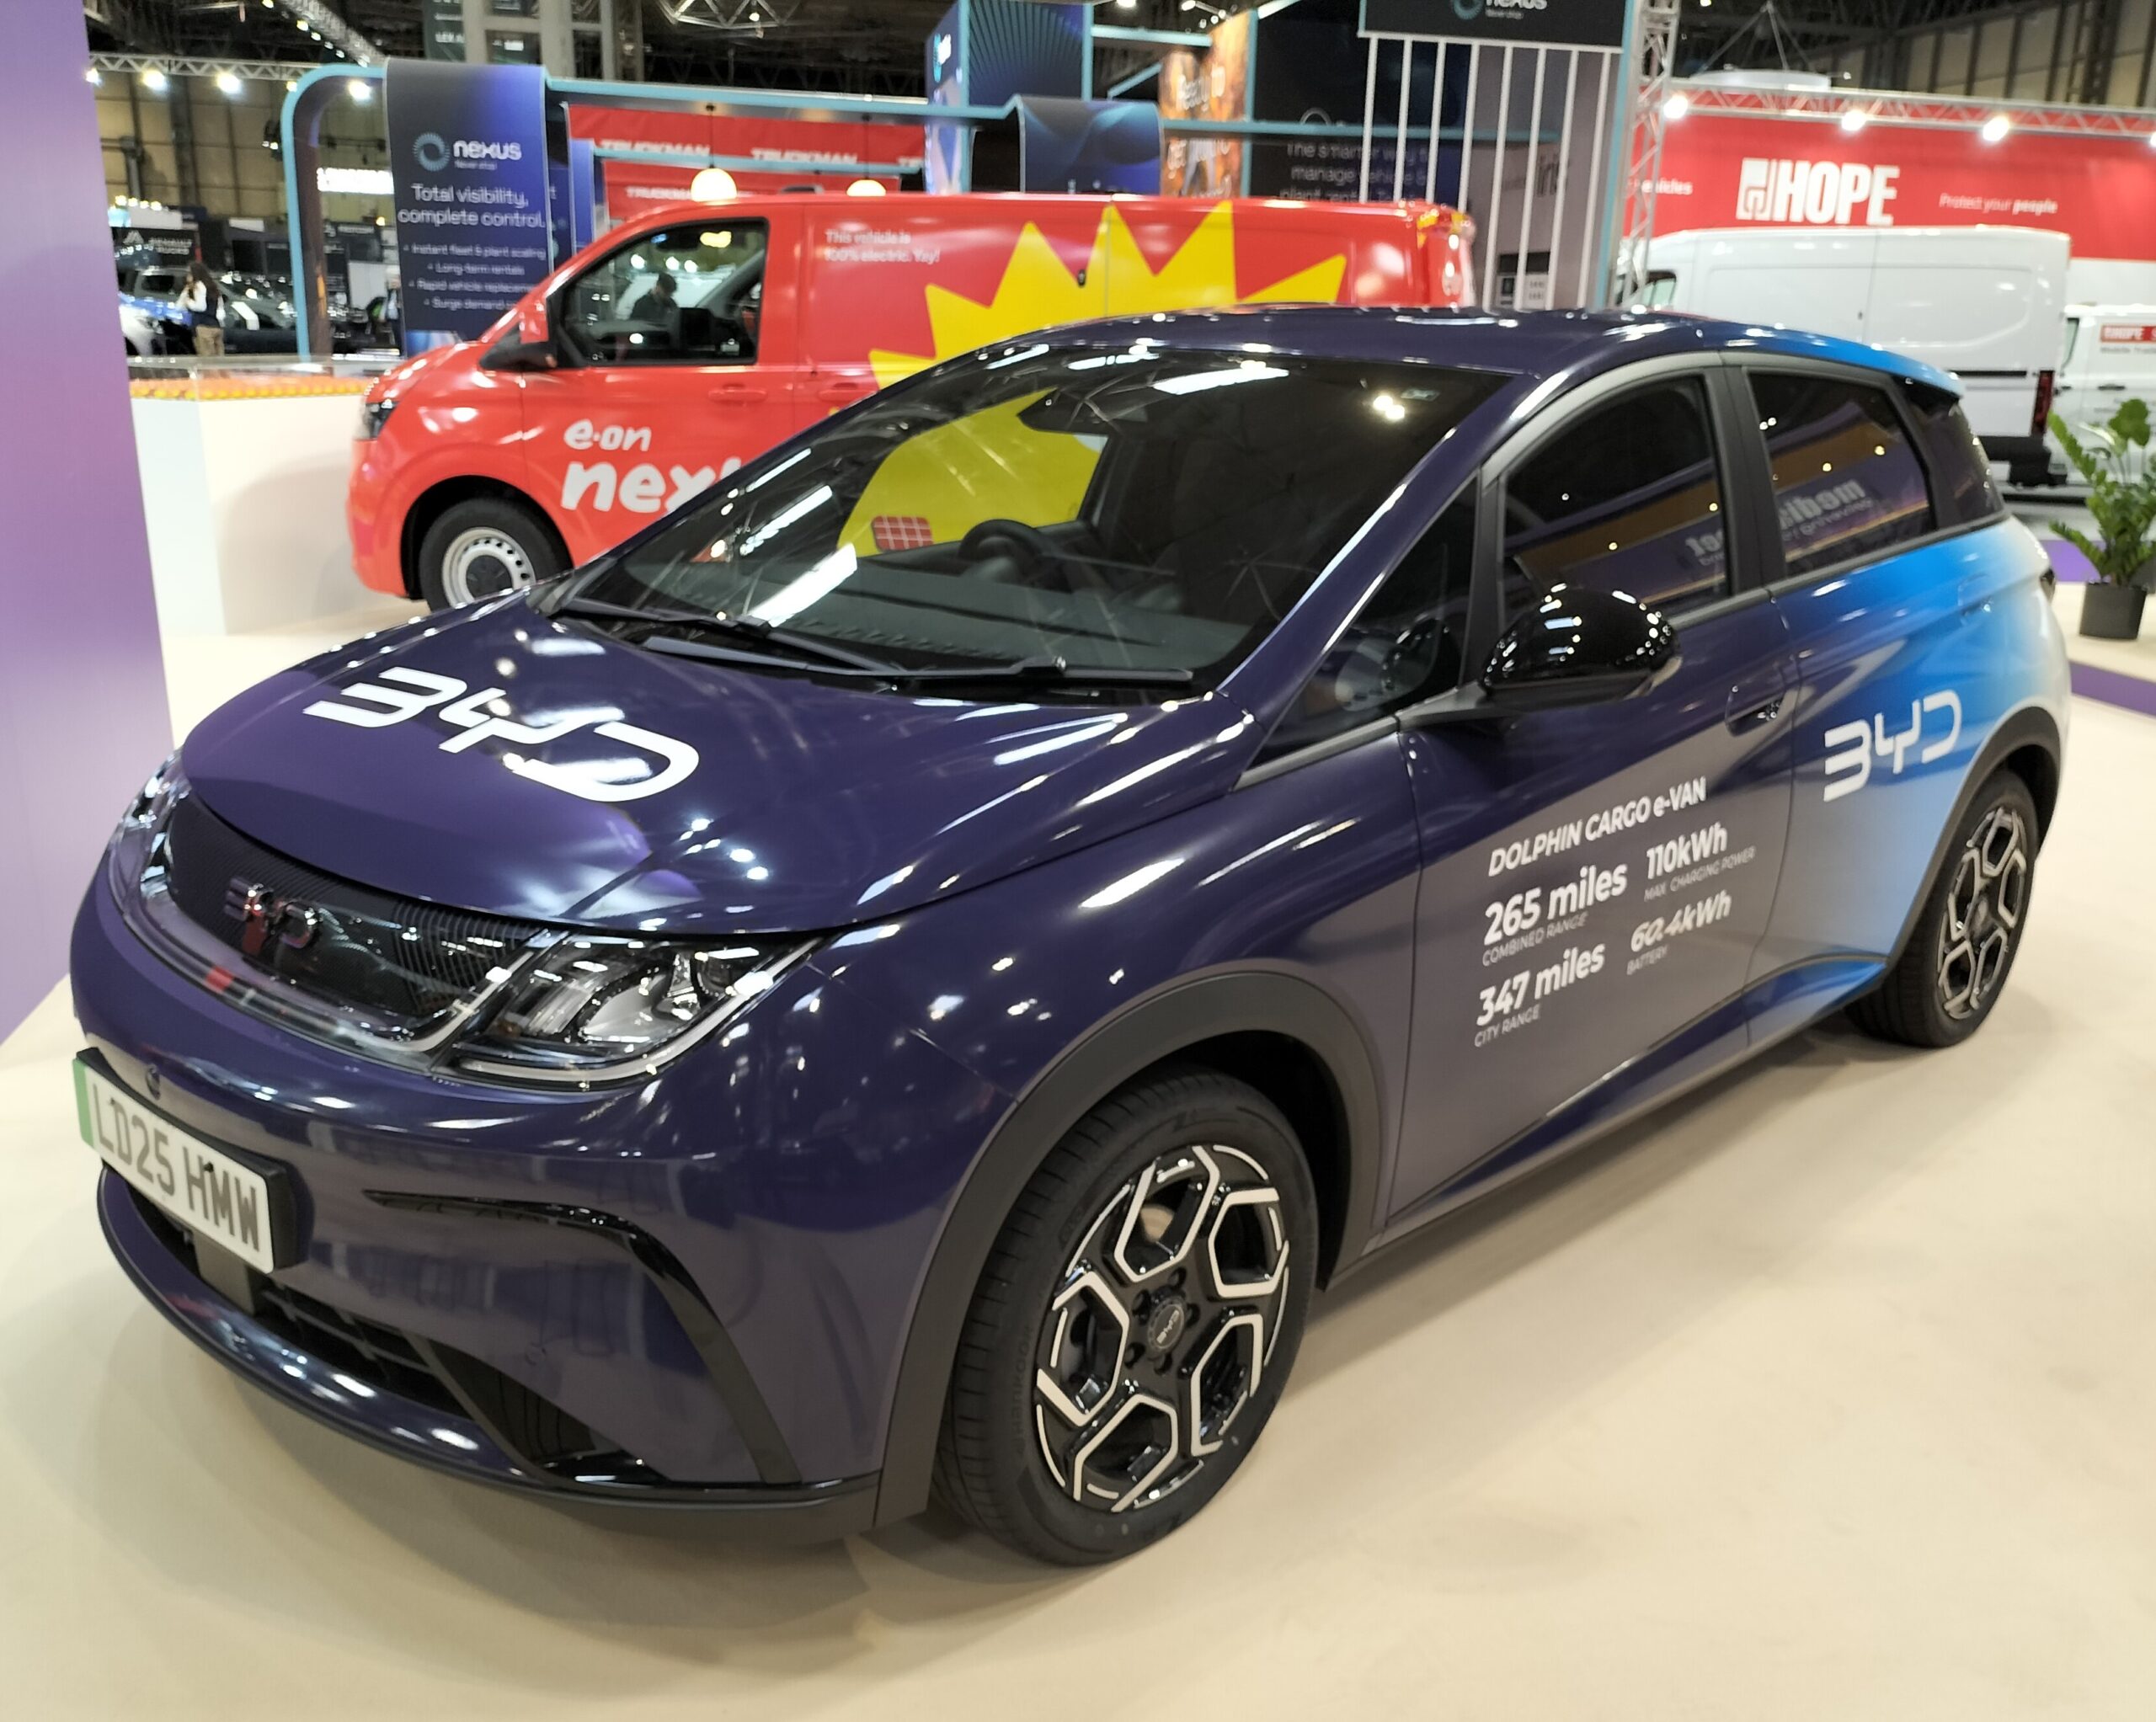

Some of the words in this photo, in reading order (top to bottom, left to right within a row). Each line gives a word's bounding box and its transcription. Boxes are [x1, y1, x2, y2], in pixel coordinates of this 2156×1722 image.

[453, 140, 522, 160] nexus
[1291, 167, 1356, 186] manage
[397, 209, 479, 227] complete
[480, 211, 546, 228] control.
[411, 183, 455, 202] Total
[456, 185, 529, 209] visibility,
[1771, 159, 1899, 226] HOPE
[1939, 193, 1983, 210] Protect
[1983, 198, 2012, 213] your
[2012, 198, 2058, 216] people
[825, 229, 852, 243] This
[854, 229, 898, 244] vehicle
[899, 229, 911, 244] is
[302, 666, 700, 802] BYD
[1823, 689, 1962, 802] BYD
[1488, 819, 1582, 877] DOLPHIN
[1585, 796, 1651, 841] CARGO
[1653, 776, 1707, 818] e-VAN
[1646, 822, 1728, 880] 110kWh
[1644, 882, 1667, 902] MAX
[1669, 861, 1720, 893] CHARGING
[1721, 845, 1757, 871] POWER
[1484, 887, 1541, 946] 265
[1547, 864, 1628, 920] miles
[1630, 889, 1732, 953] 60.4kWh
[1482, 927, 1545, 967] COMBINED
[1546, 911, 1589, 939] RANGE
[1626, 944, 1669, 975] BATTERY
[1476, 970, 1530, 1026] 347
[1534, 943, 1606, 1000] miles
[1474, 1025, 1500, 1048] CITY
[1502, 1005, 1540, 1034] RANGE
[93, 1083, 175, 1197] LD25
[183, 1146, 260, 1253] HMW
